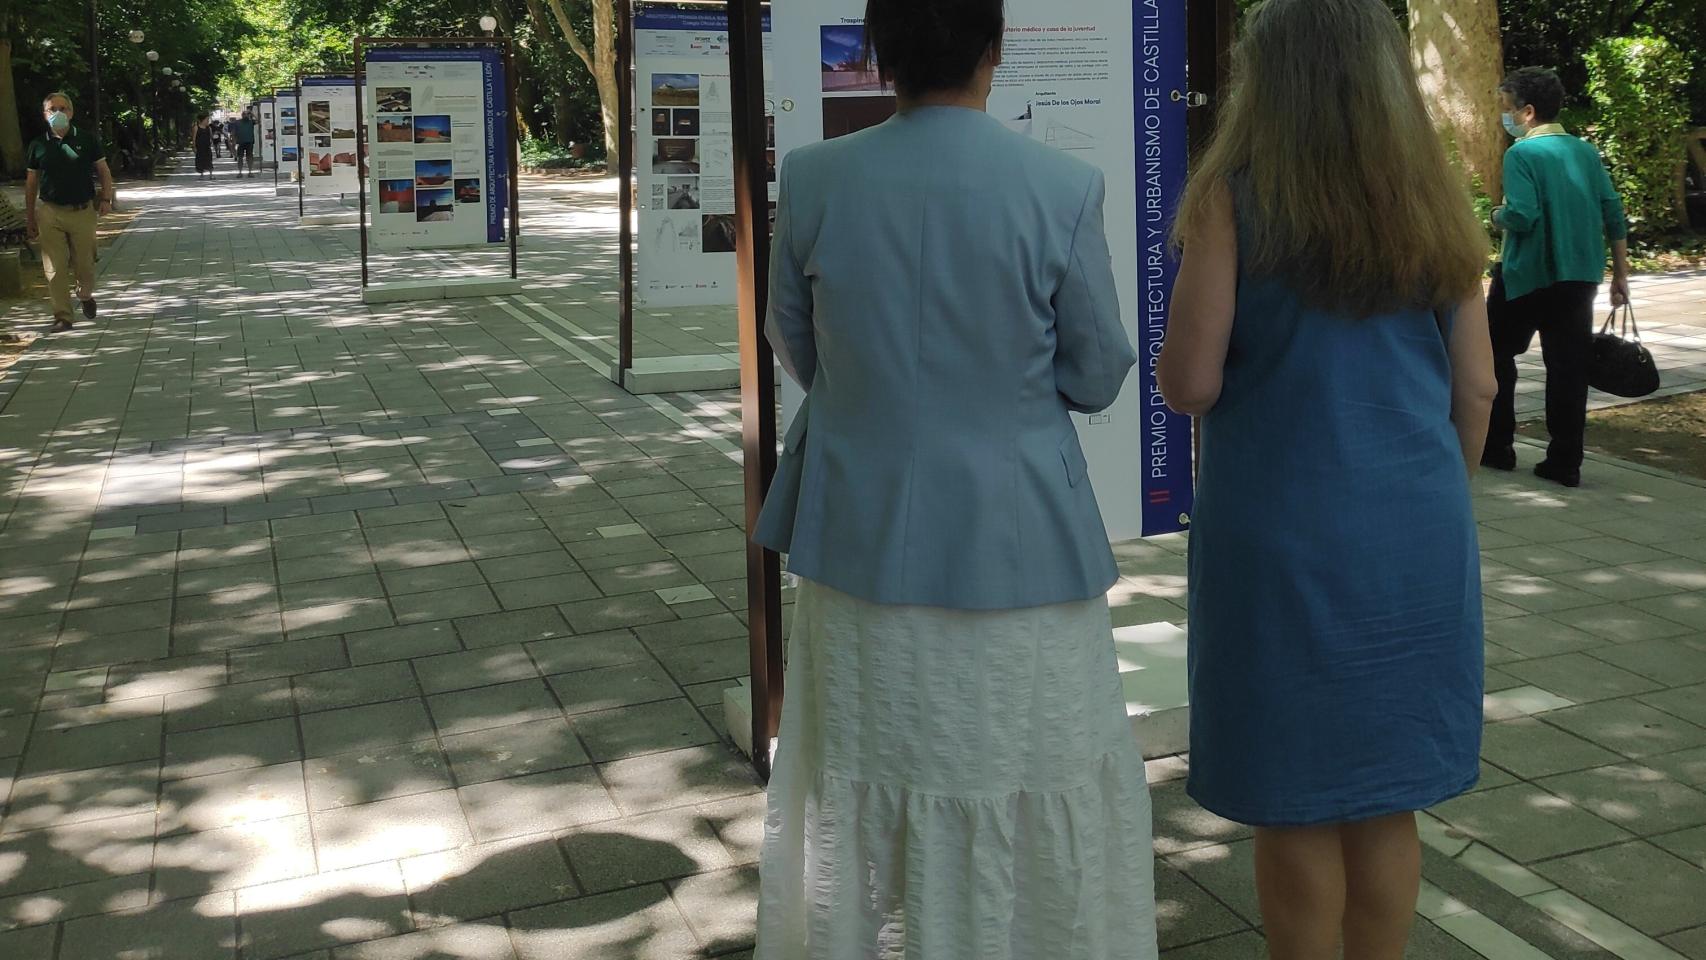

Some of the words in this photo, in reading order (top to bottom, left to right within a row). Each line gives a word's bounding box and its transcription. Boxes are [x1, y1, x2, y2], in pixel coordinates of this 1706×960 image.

[1142, 0, 1160, 83] CASTILLA
[1070, 99, 1083, 107] Ojos
[1144, 87, 1160, 110] DE
[1144, 114, 1162, 222] URBANISMO
[1146, 227, 1162, 239] Y
[1150, 411, 1167, 478] PREMIO
